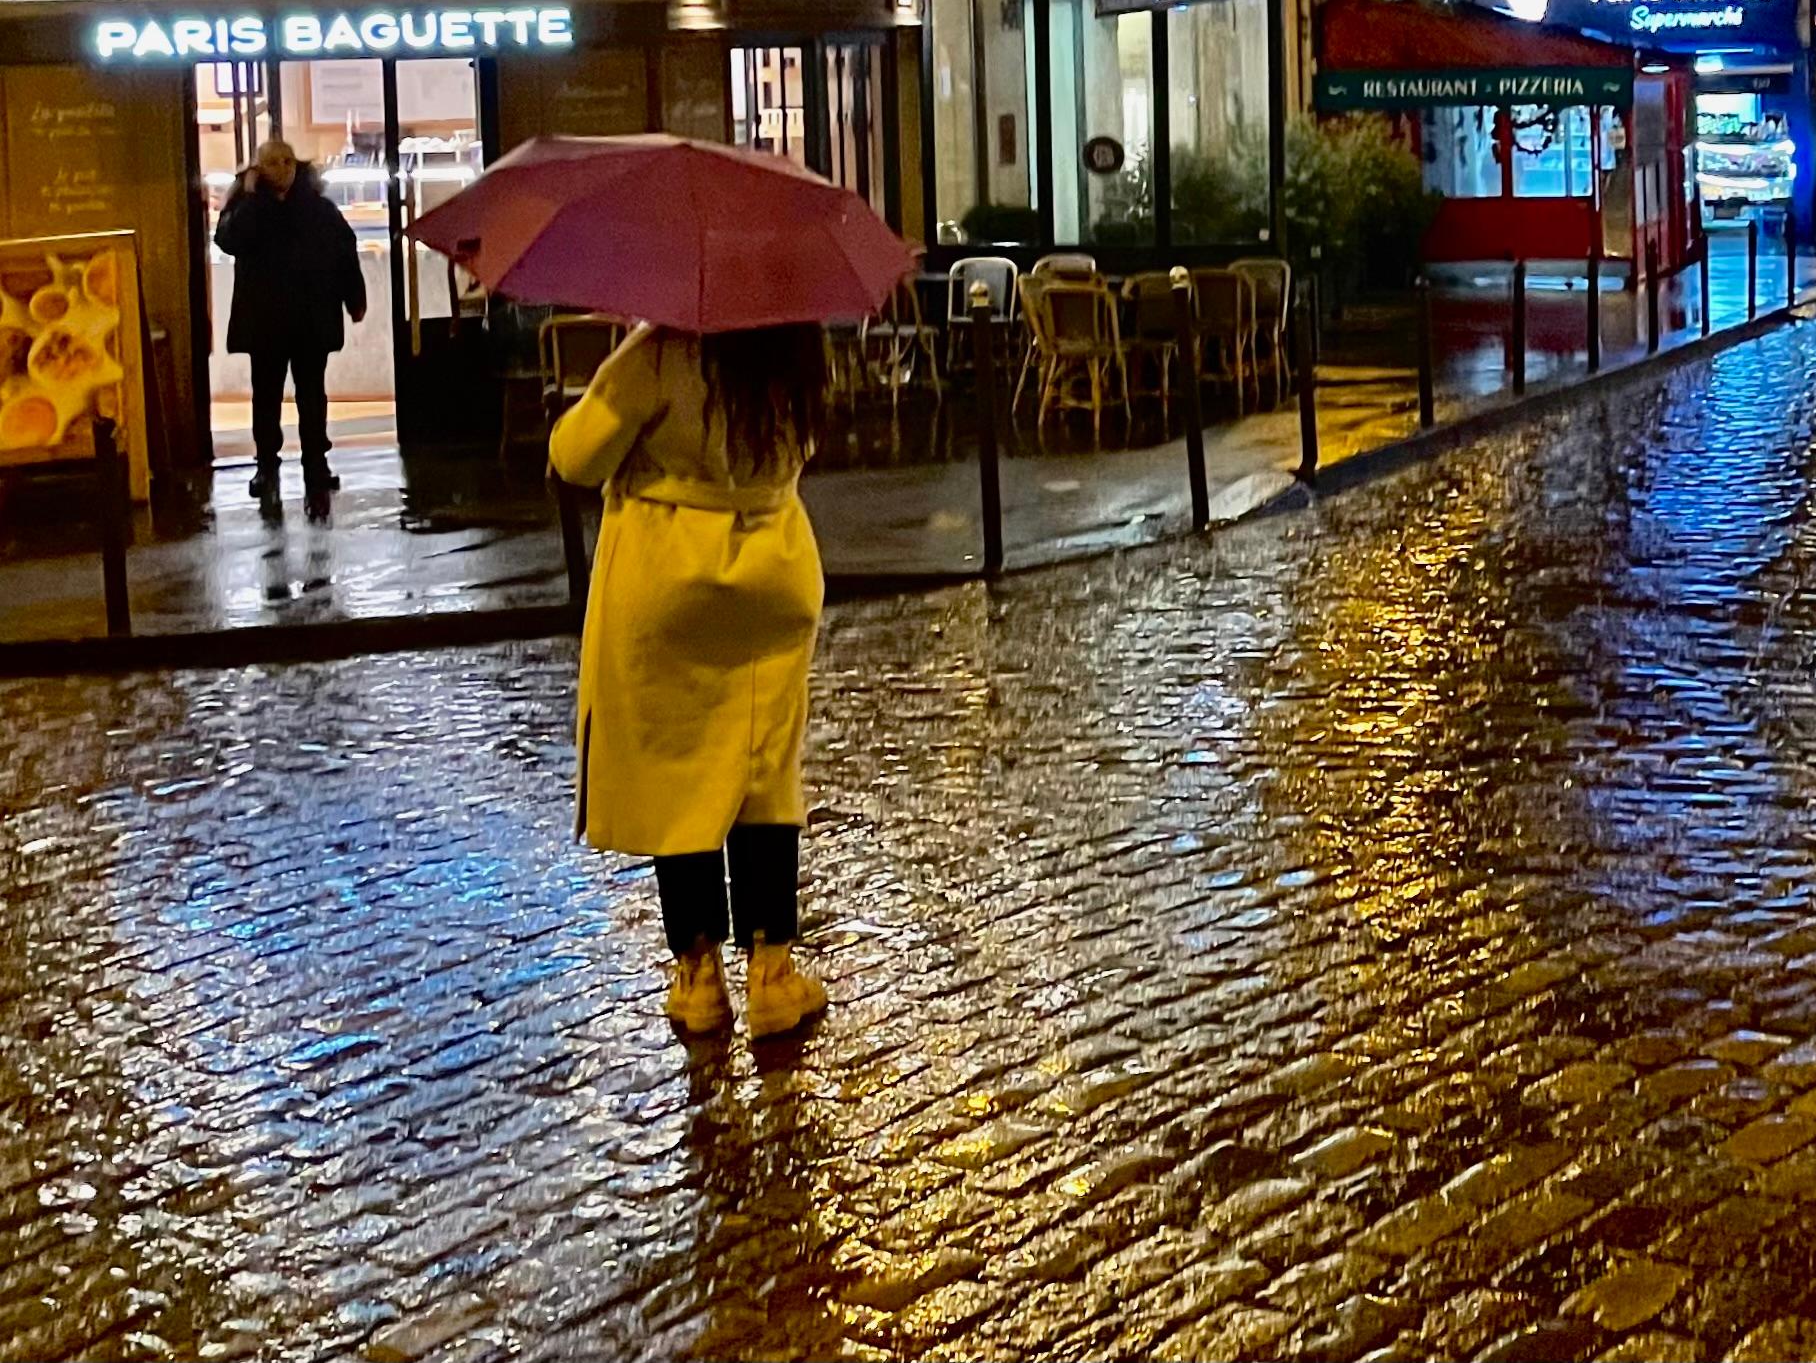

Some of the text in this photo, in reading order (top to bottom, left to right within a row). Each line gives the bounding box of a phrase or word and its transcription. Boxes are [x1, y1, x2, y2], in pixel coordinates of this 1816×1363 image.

[97, 7, 573, 57] PARIS BAGUETTE
[1363, 76, 1584, 98] RESTAURANT PIZZERIA
